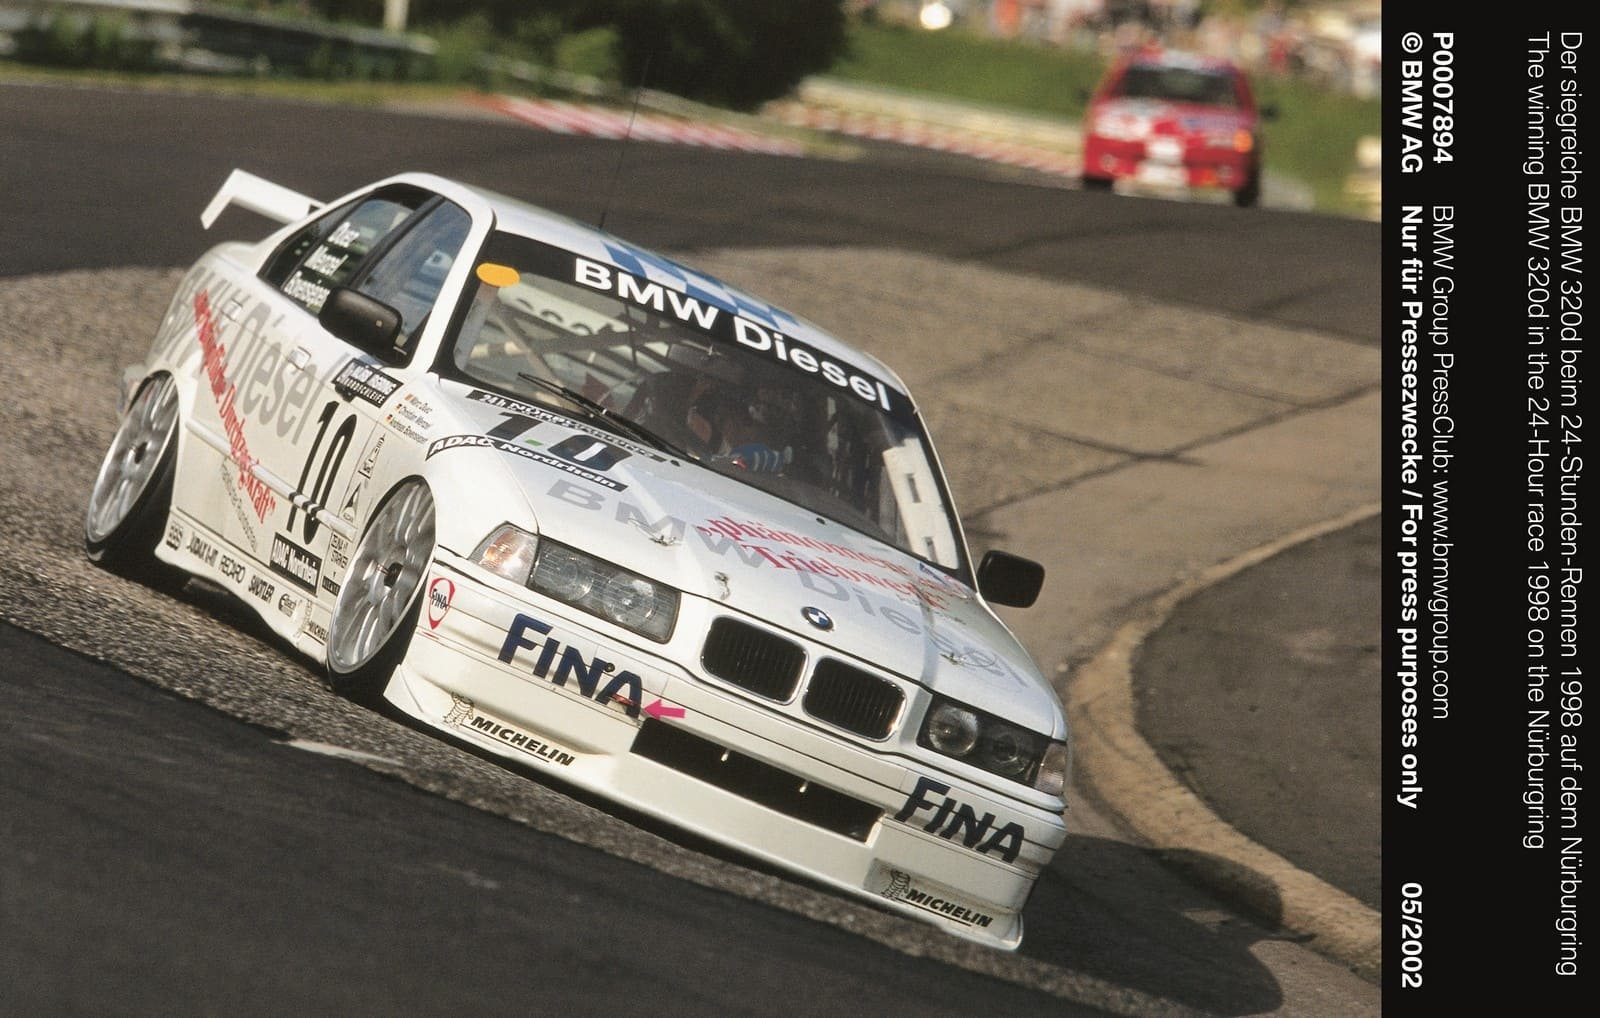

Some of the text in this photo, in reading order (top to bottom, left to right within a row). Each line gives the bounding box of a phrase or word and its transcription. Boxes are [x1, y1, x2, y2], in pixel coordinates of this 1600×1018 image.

[575, 257, 718, 330] BMW
[735, 313, 892, 412] Diesel
[221, 301, 352, 447] Diesel
[479, 393, 508, 411] 24h
[430, 436, 618, 489] ADAC Nordrhein
[486, 411, 633, 472] 10
[286, 401, 357, 545] 10
[546, 478, 769, 569] BMW
[272, 538, 290, 569] ADAC
[287, 547, 318, 587] Nordrhein
[429, 588, 450, 612] FINA
[497, 612, 643, 719] FINA
[470, 715, 576, 768] MICHELIN
[893, 775, 1025, 864] FINA
[905, 887, 994, 928] MICHELIN
